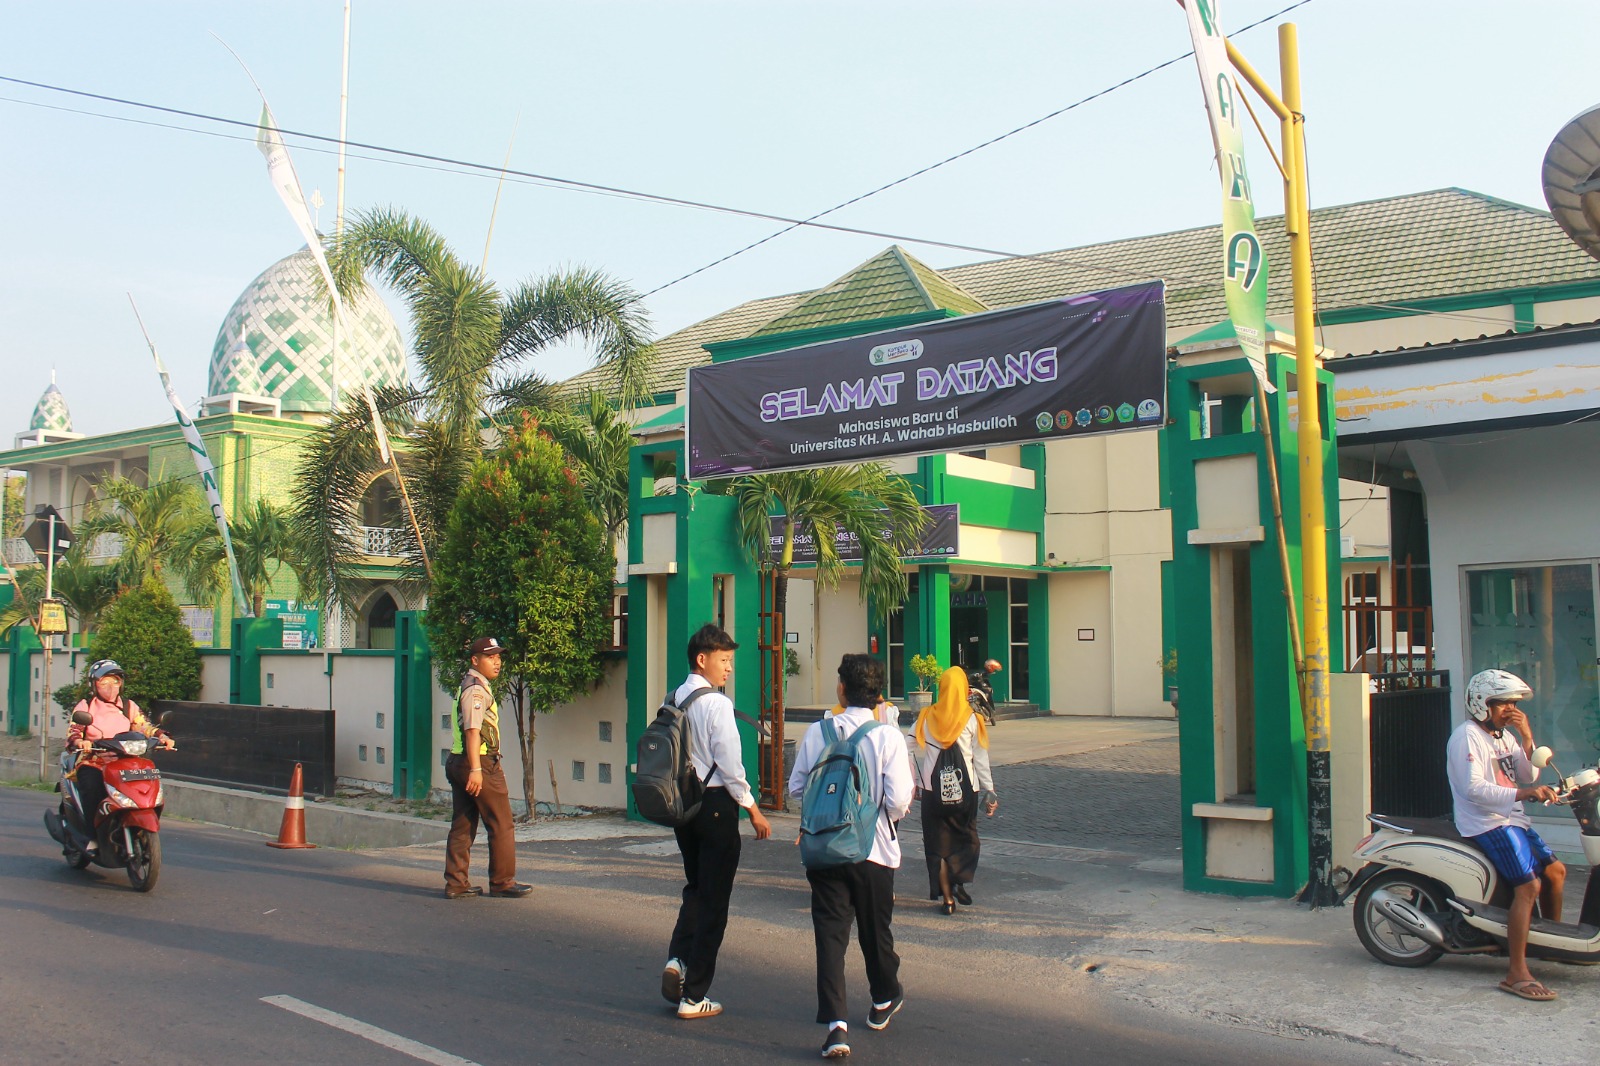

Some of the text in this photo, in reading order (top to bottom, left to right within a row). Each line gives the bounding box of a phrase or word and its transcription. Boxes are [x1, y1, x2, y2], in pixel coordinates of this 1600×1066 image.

[760, 346, 1058, 422] SELAMAT DATANG
[790, 414, 1018, 454] Universitas KH. A. Wahab Hasbulloh
[839, 405, 959, 435] Mahasiswa Baru di
